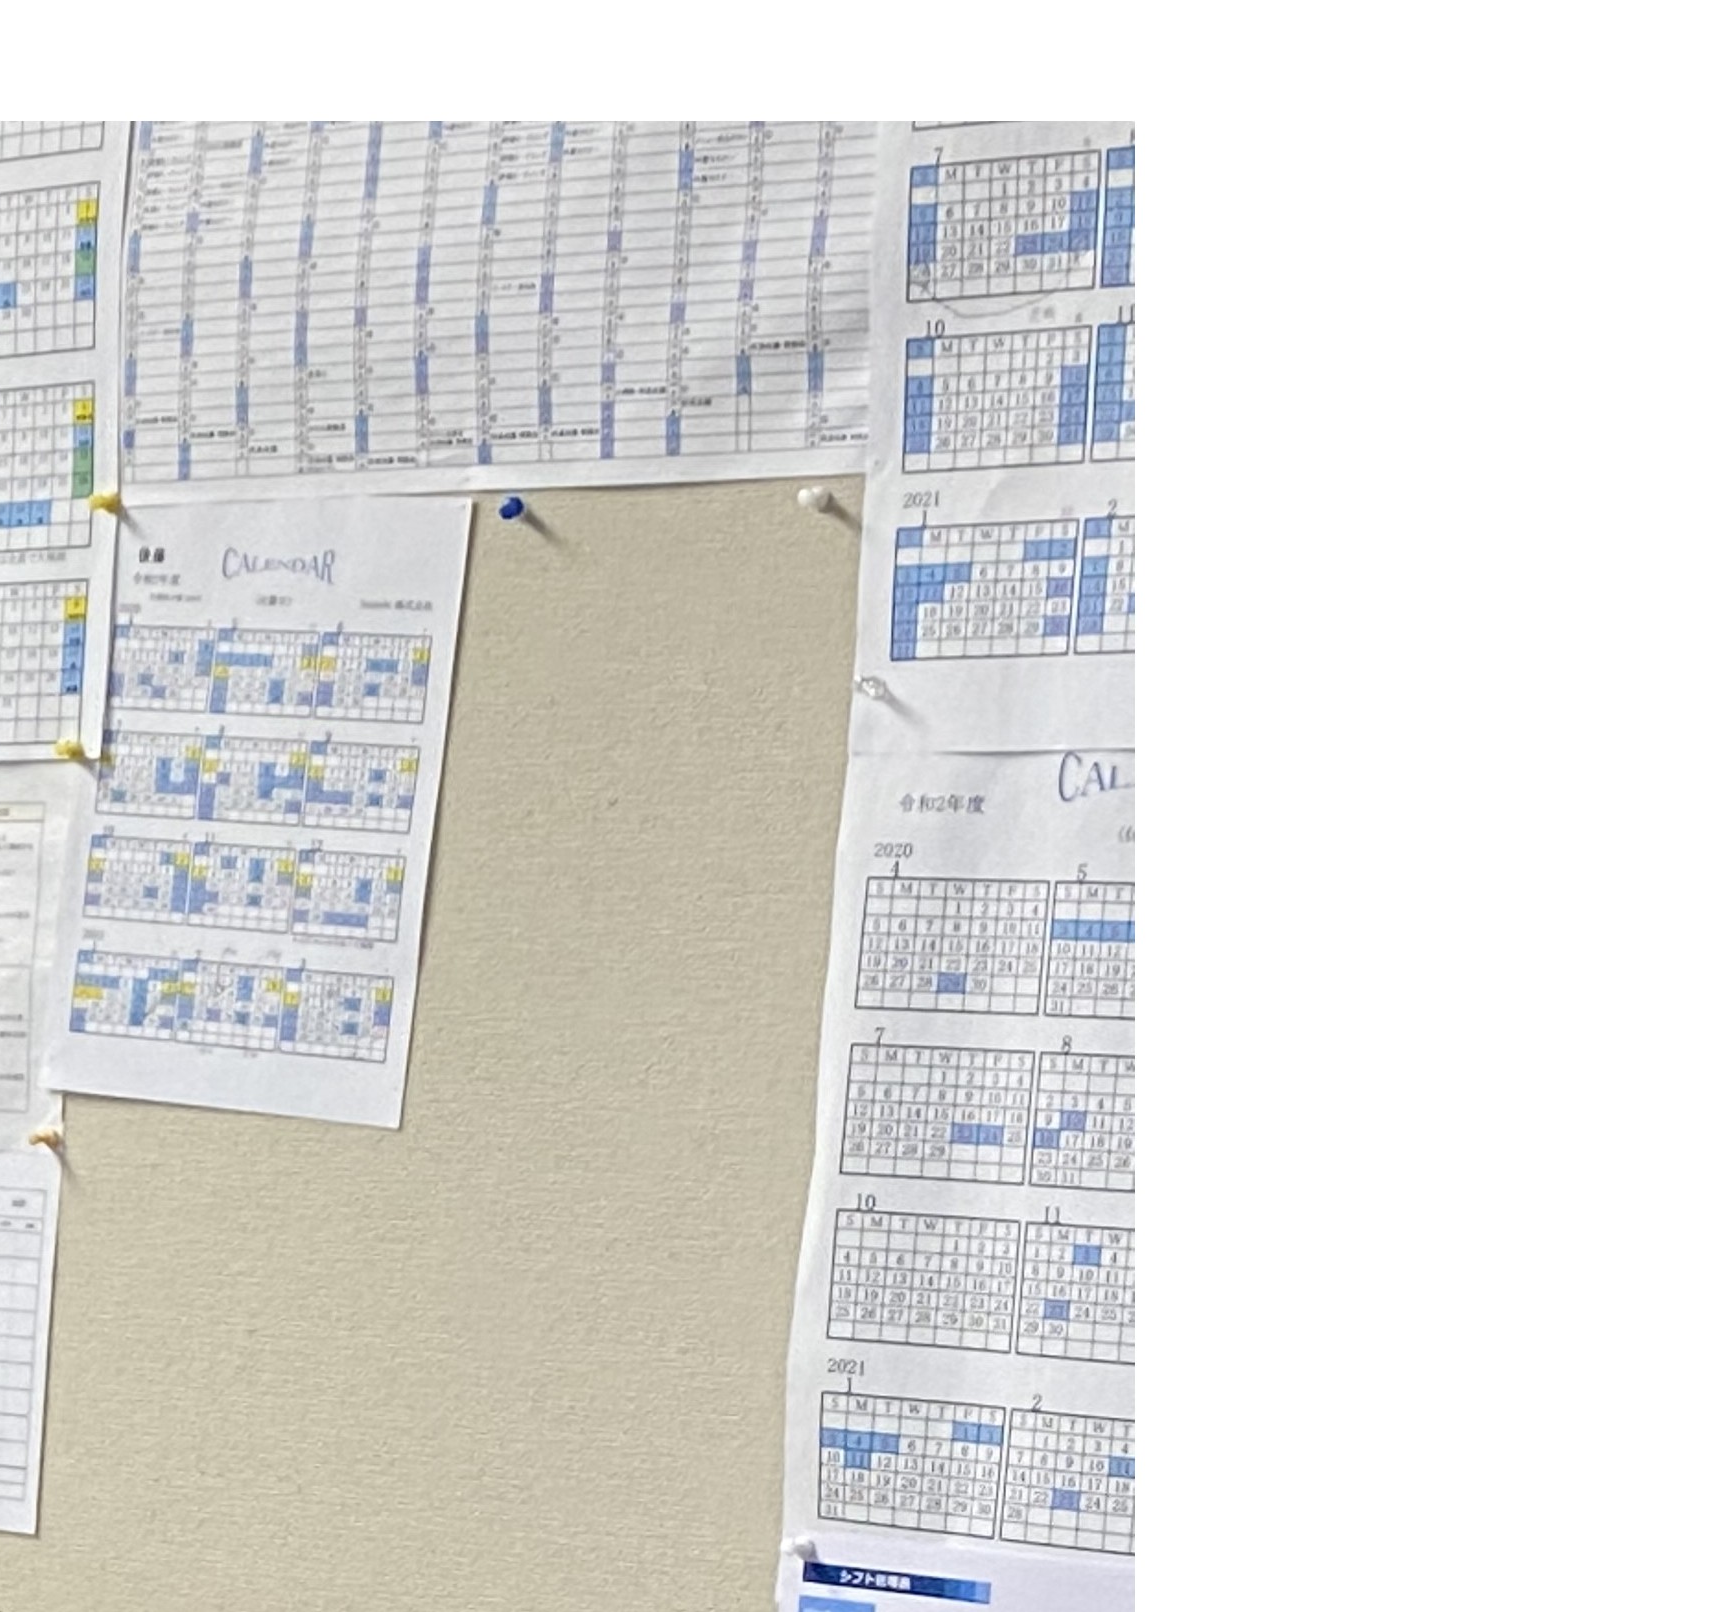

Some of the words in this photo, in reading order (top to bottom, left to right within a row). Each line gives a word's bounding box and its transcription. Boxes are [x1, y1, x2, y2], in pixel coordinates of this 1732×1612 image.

[926, 320, 945, 337] 10
[903, 491, 940, 509] 2021
[222, 547, 335, 584] CALENDAR
[899, 793, 985, 813] 令和2年度
[874, 843, 913, 858] 2020
[1002, 921, 1017, 935] 10
[894, 936, 910, 951] 13
[920, 938, 936, 952] 14
[875, 1027, 885, 1045] 7
[1062, 1036, 1072, 1053] 8
[987, 1091, 1002, 1105] 10
[1010, 1090, 1025, 1106] 11
[853, 1103, 868, 1116] 12
[879, 1104, 894, 1118] 13
[906, 1106, 921, 1119] 14
[985, 1108, 1000, 1123] 17
[903, 1122, 918, 1138] 21
[857, 1193, 876, 1211] 10
[1045, 1206, 1061, 1223] 11
[997, 1260, 1012, 1275] 10
[838, 1268, 851, 1282] 11
[864, 1268, 880, 1284] 12
[892, 1271, 908, 1285] 13
[919, 1274, 933, 1287] 14
[996, 1279, 1011, 1293] 17
[915, 1291, 931, 1306] 21
[827, 1359, 865, 1376] 2021
[1032, 1394, 1043, 1412] 2
[825, 1450, 840, 1464] 10
[876, 1455, 892, 1470] 12
[902, 1457, 918, 1471] 13
[930, 1460, 945, 1475] 14
[823, 1467, 839, 1482] 17
[927, 1478, 942, 1492] 21
